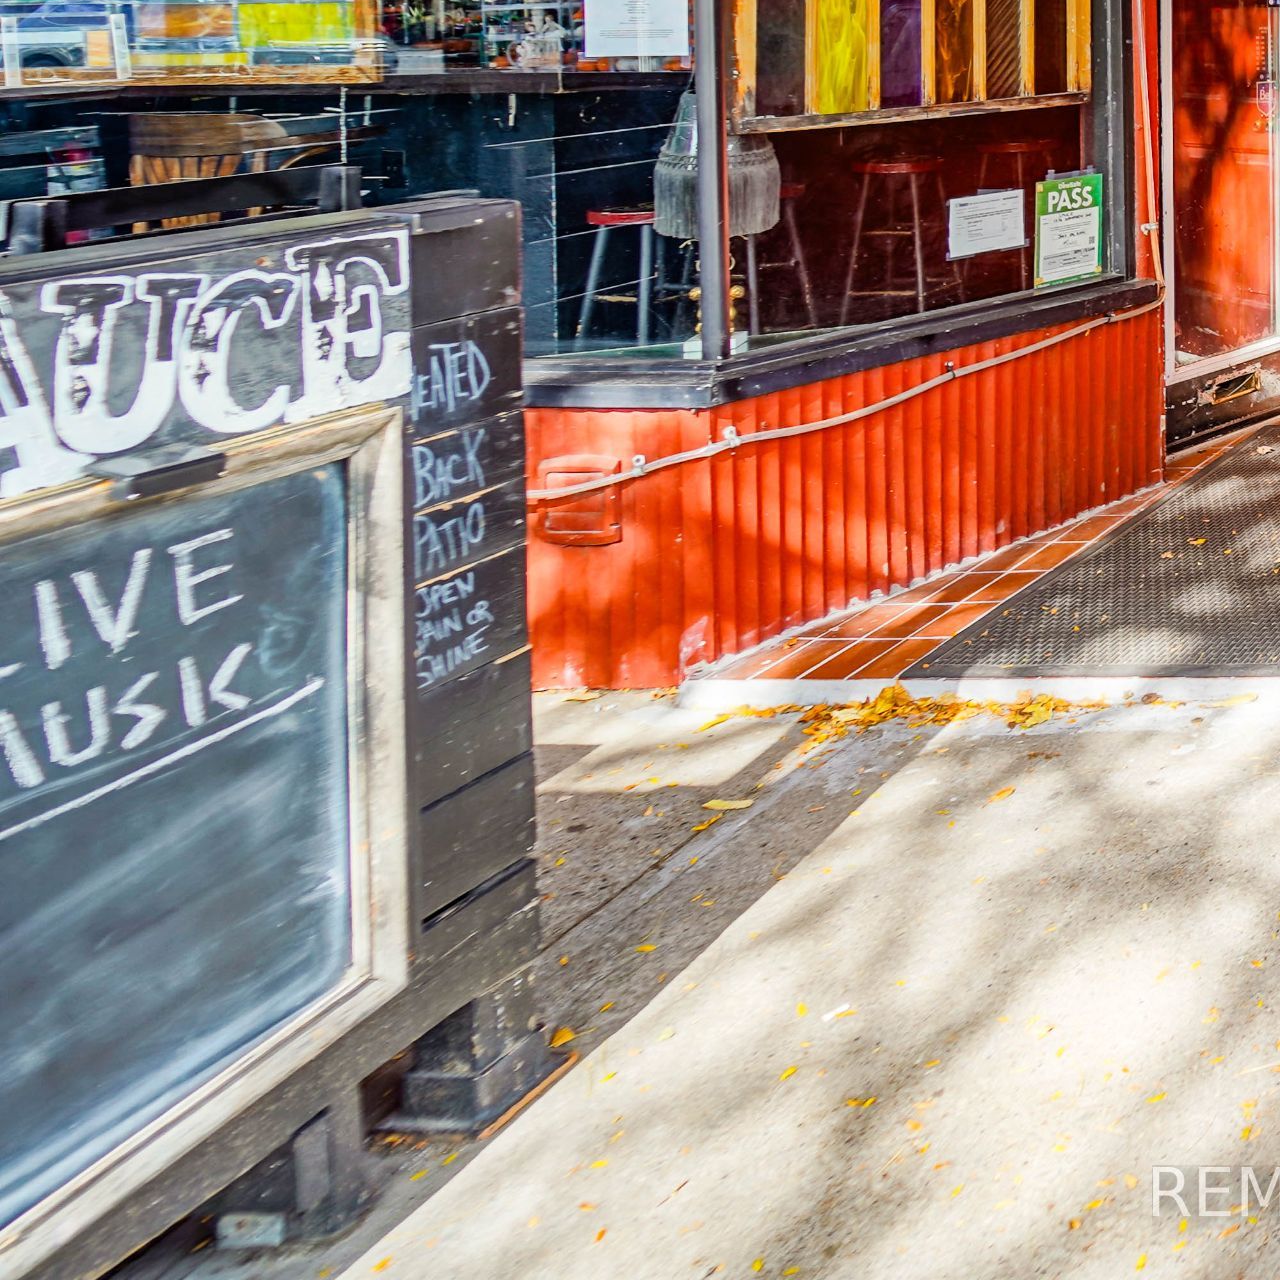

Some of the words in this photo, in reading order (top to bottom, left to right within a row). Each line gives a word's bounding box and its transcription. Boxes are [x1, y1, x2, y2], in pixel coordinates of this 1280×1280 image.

[1047, 185, 1093, 213] PASS
[412, 428, 487, 509] BACK
[413, 502, 486, 579] PATIO
[0, 528, 244, 678] IVE
[465, 600, 496, 626] OR
[415, 624, 491, 689] SHINE
